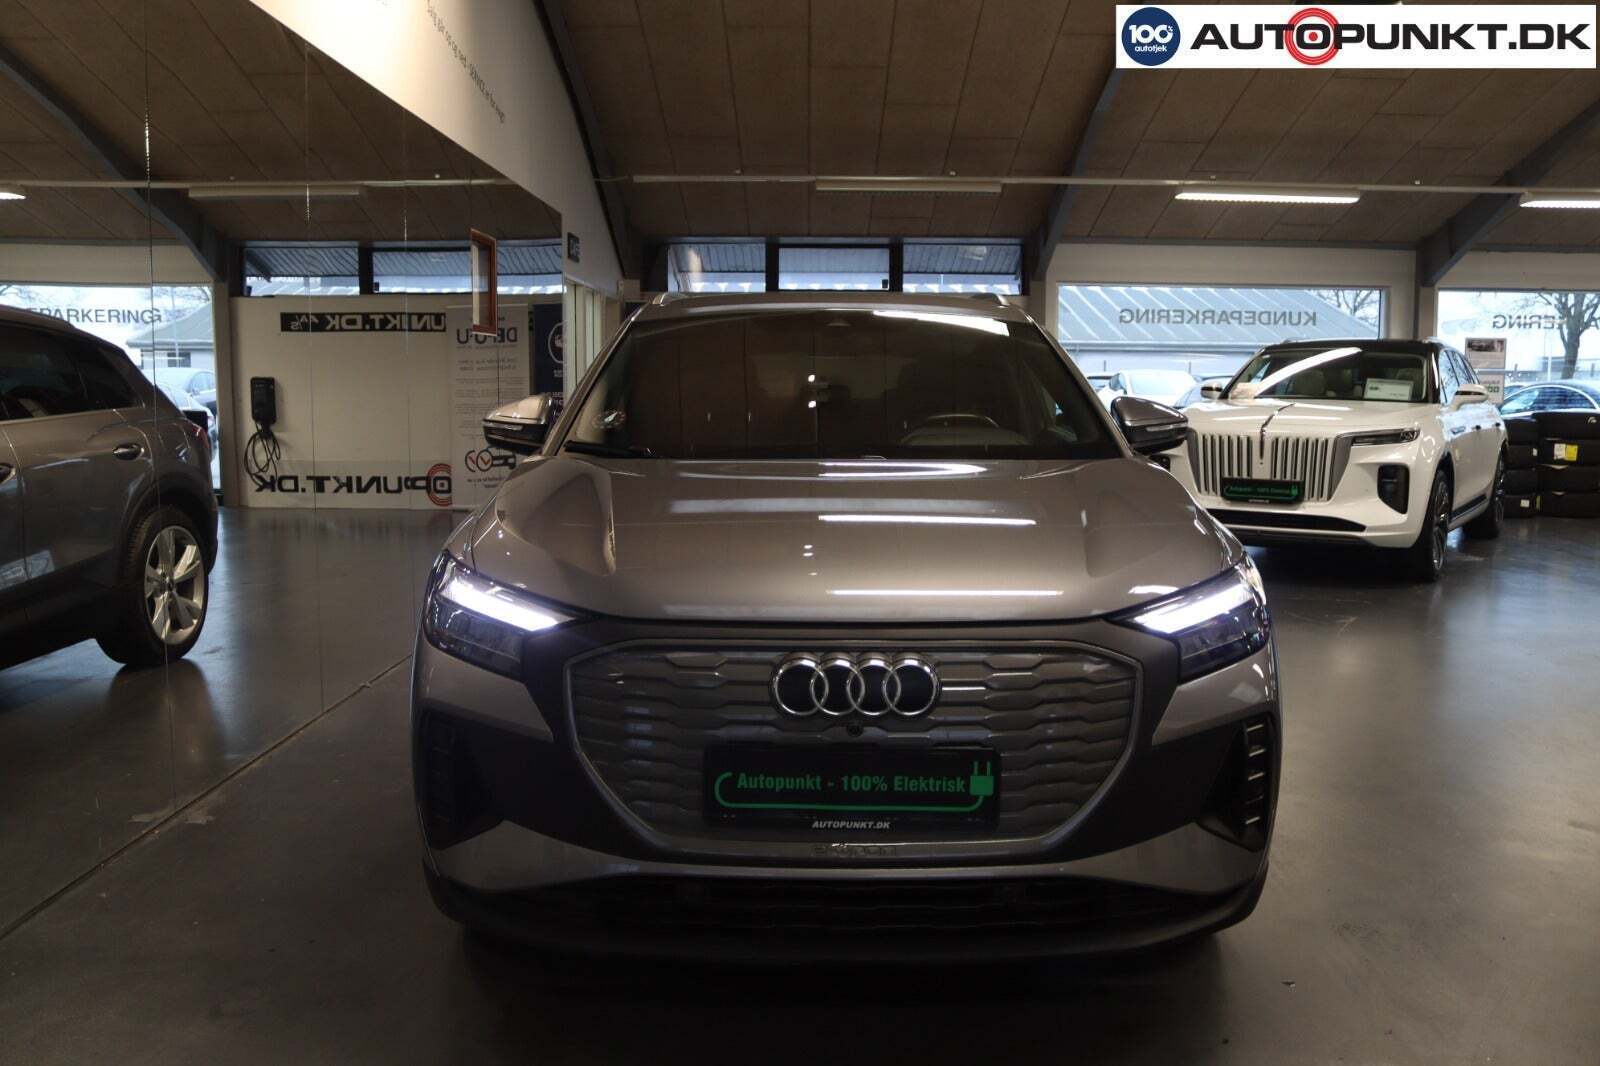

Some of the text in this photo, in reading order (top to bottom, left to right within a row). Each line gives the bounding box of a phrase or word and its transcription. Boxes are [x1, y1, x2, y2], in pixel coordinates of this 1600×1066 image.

[737, 772, 822, 791] Autopunkt
[842, 775, 888, 791] 100%
[894, 775, 965, 793] Elektrisk
[812, 820, 891, 829] AUTOPUNKT.DK
